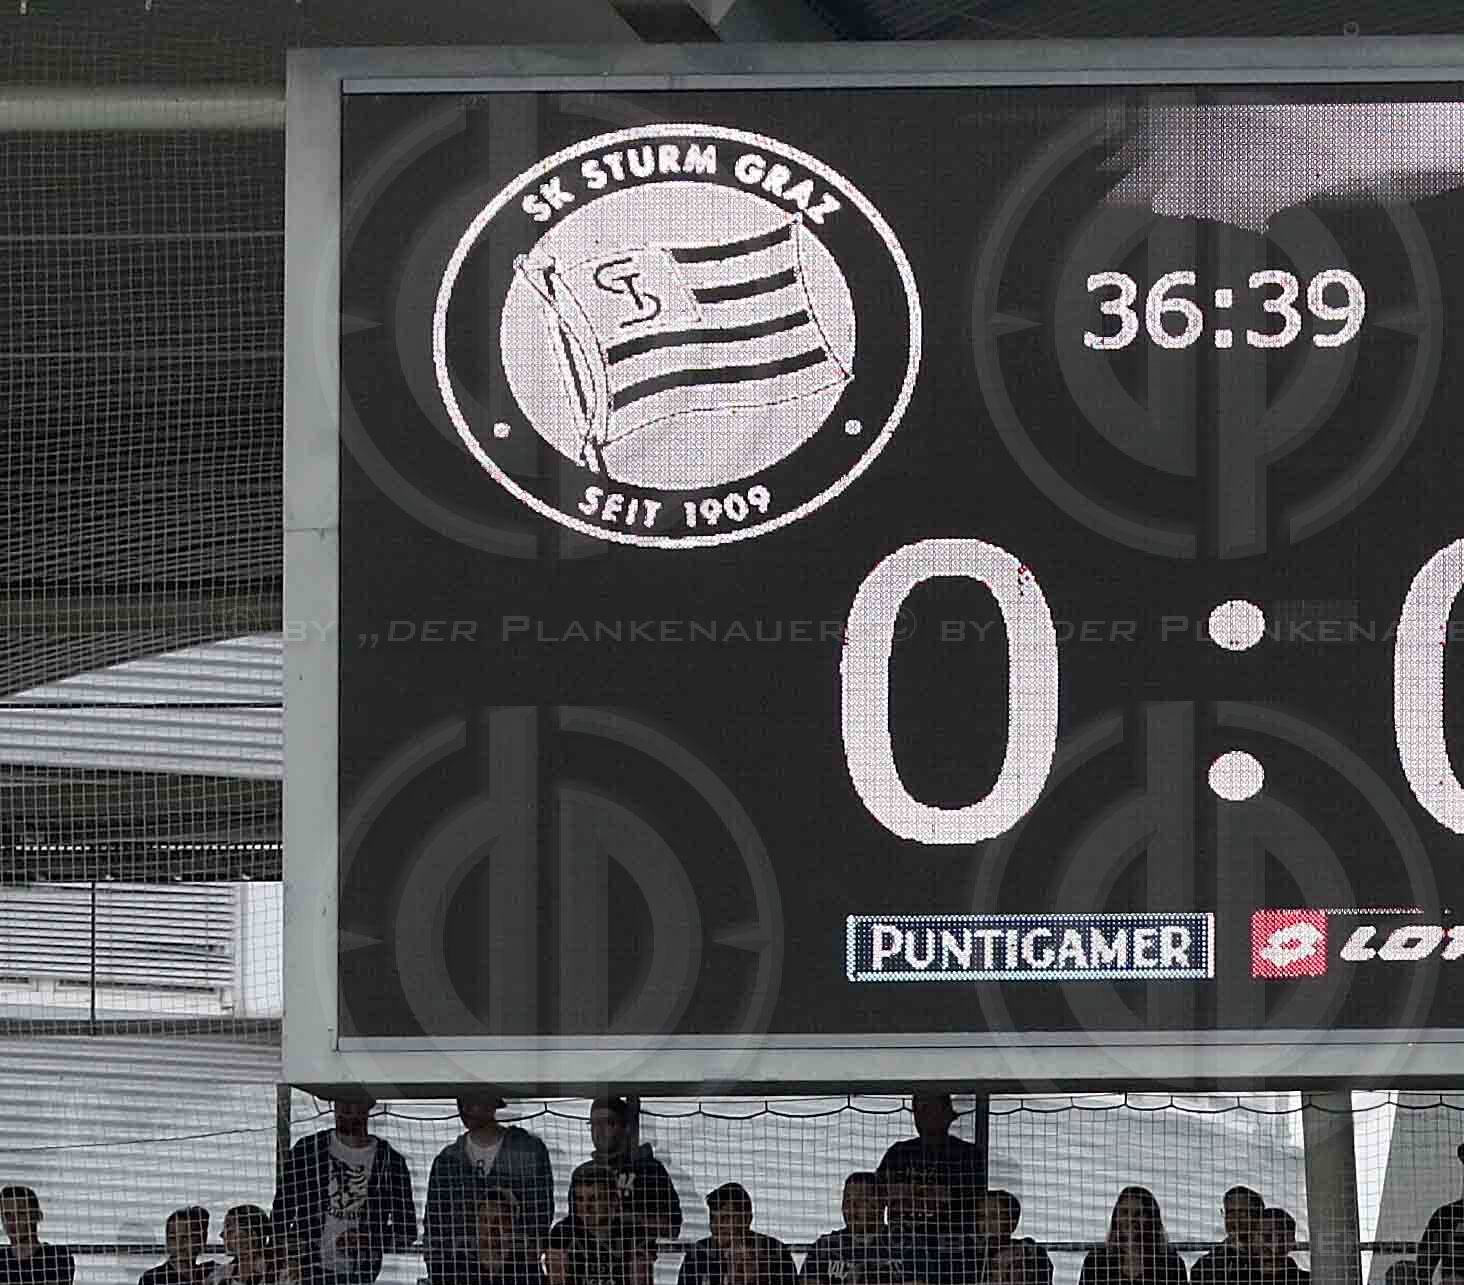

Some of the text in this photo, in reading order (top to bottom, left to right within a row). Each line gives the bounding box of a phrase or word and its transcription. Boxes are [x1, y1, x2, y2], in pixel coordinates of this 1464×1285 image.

[520, 142, 843, 226] SK STURM GRAZ
[1083, 269, 1367, 351] 36:39
[576, 483, 774, 529] SEIT 1909
[840, 537, 1060, 845] 0
[869, 923, 1192, 973] PUNTIGAMER
